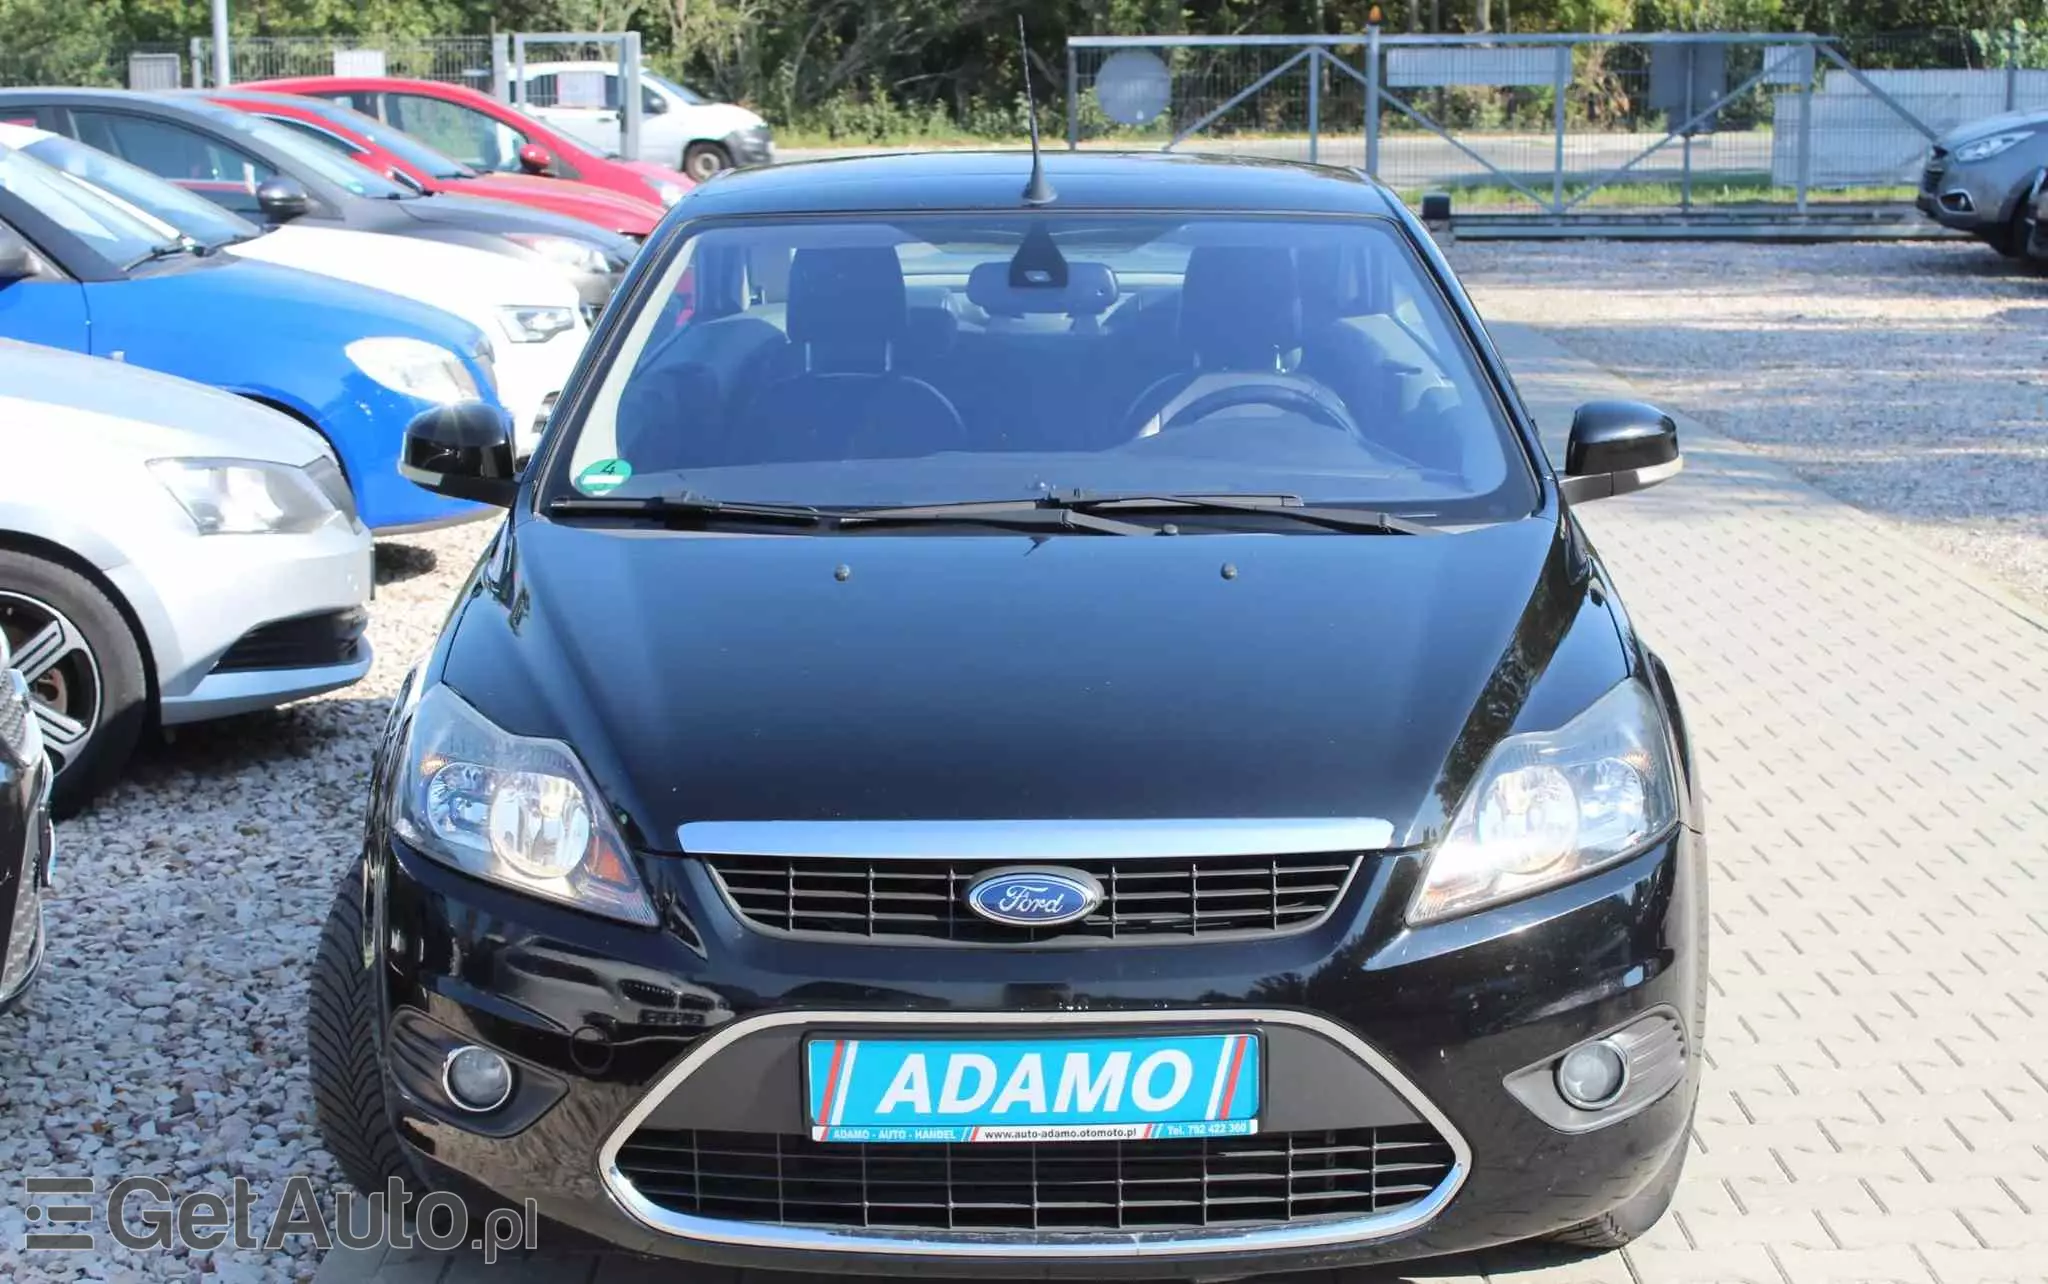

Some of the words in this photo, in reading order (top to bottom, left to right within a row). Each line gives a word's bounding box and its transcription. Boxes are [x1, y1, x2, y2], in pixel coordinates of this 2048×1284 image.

[600, 461, 616, 475] 4
[999, 885, 1064, 913] Ford
[876, 1050, 1193, 1114] ADAMO
[833, 1129, 868, 1139] ADAMO
[878, 1128, 906, 1138] AUTO
[915, 1128, 956, 1139] HANDEL
[985, 1128, 1137, 1139] www.auto-adamo.otomoto.pl
